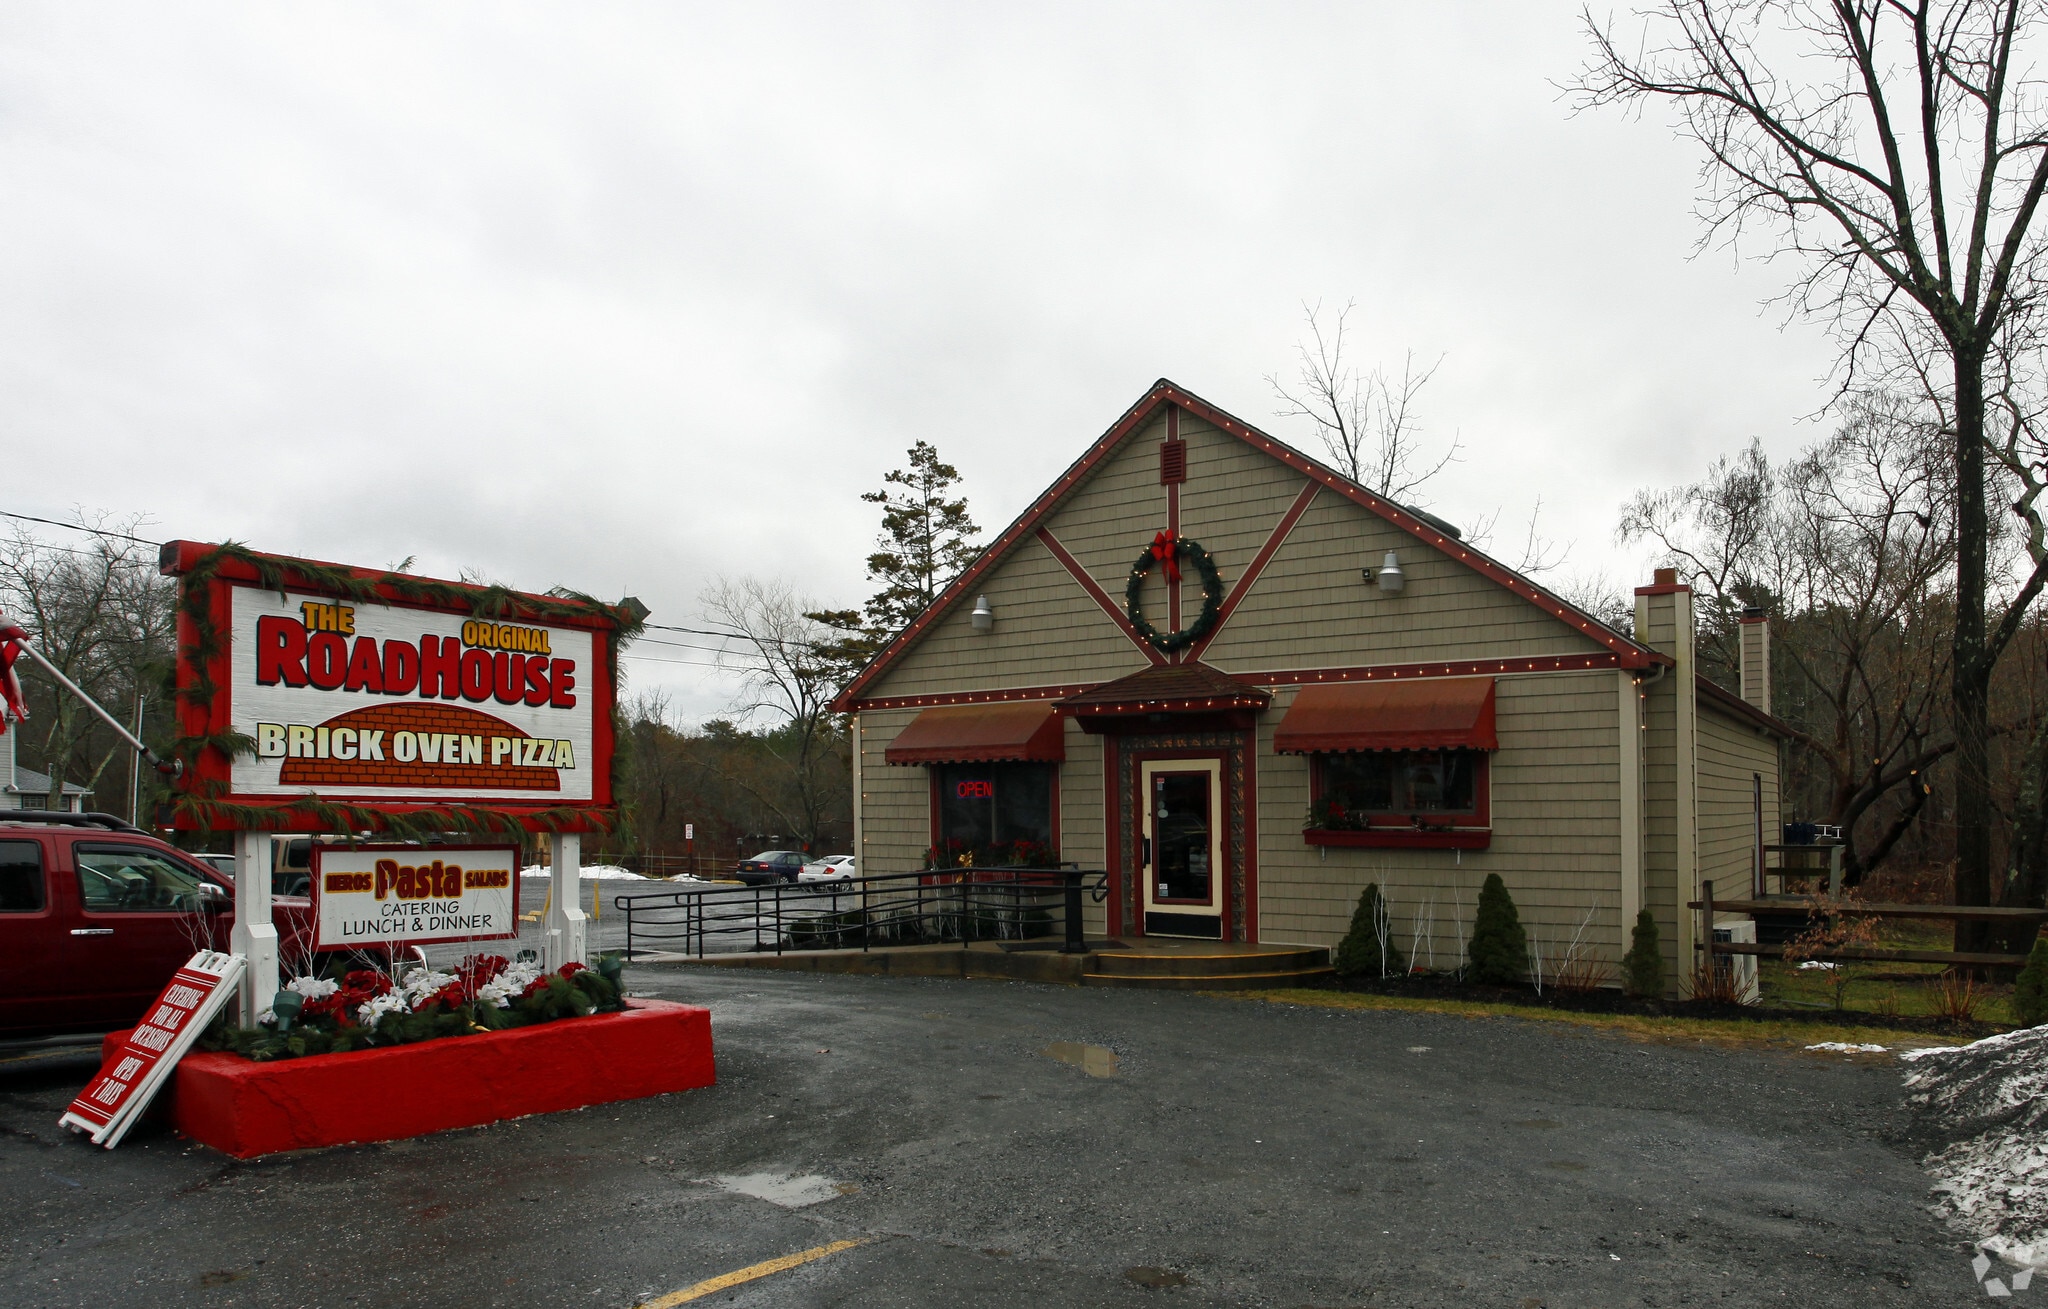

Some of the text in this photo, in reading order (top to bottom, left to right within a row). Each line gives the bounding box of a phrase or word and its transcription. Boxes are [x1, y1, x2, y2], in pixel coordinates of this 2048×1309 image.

[301, 601, 355, 636] THE
[461, 620, 551, 654] ORIGINAL
[256, 614, 577, 709] ROADHOUSE
[257, 722, 576, 769] BRICK OVEN PIZZA
[957, 781, 993, 797] OPEN
[324, 858, 510, 901] HEROS Pasta SALADS
[381, 901, 460, 917] CATERING
[343, 914, 493, 936] LUNCH & DINNER
[163, 984, 205, 1010] CATERING
[149, 1004, 186, 1030] FOR ALL
[130, 1023, 175, 1052] OCCASIONS
[112, 1056, 145, 1082] OPEN
[90, 1077, 127, 1106] 7 DAYS
